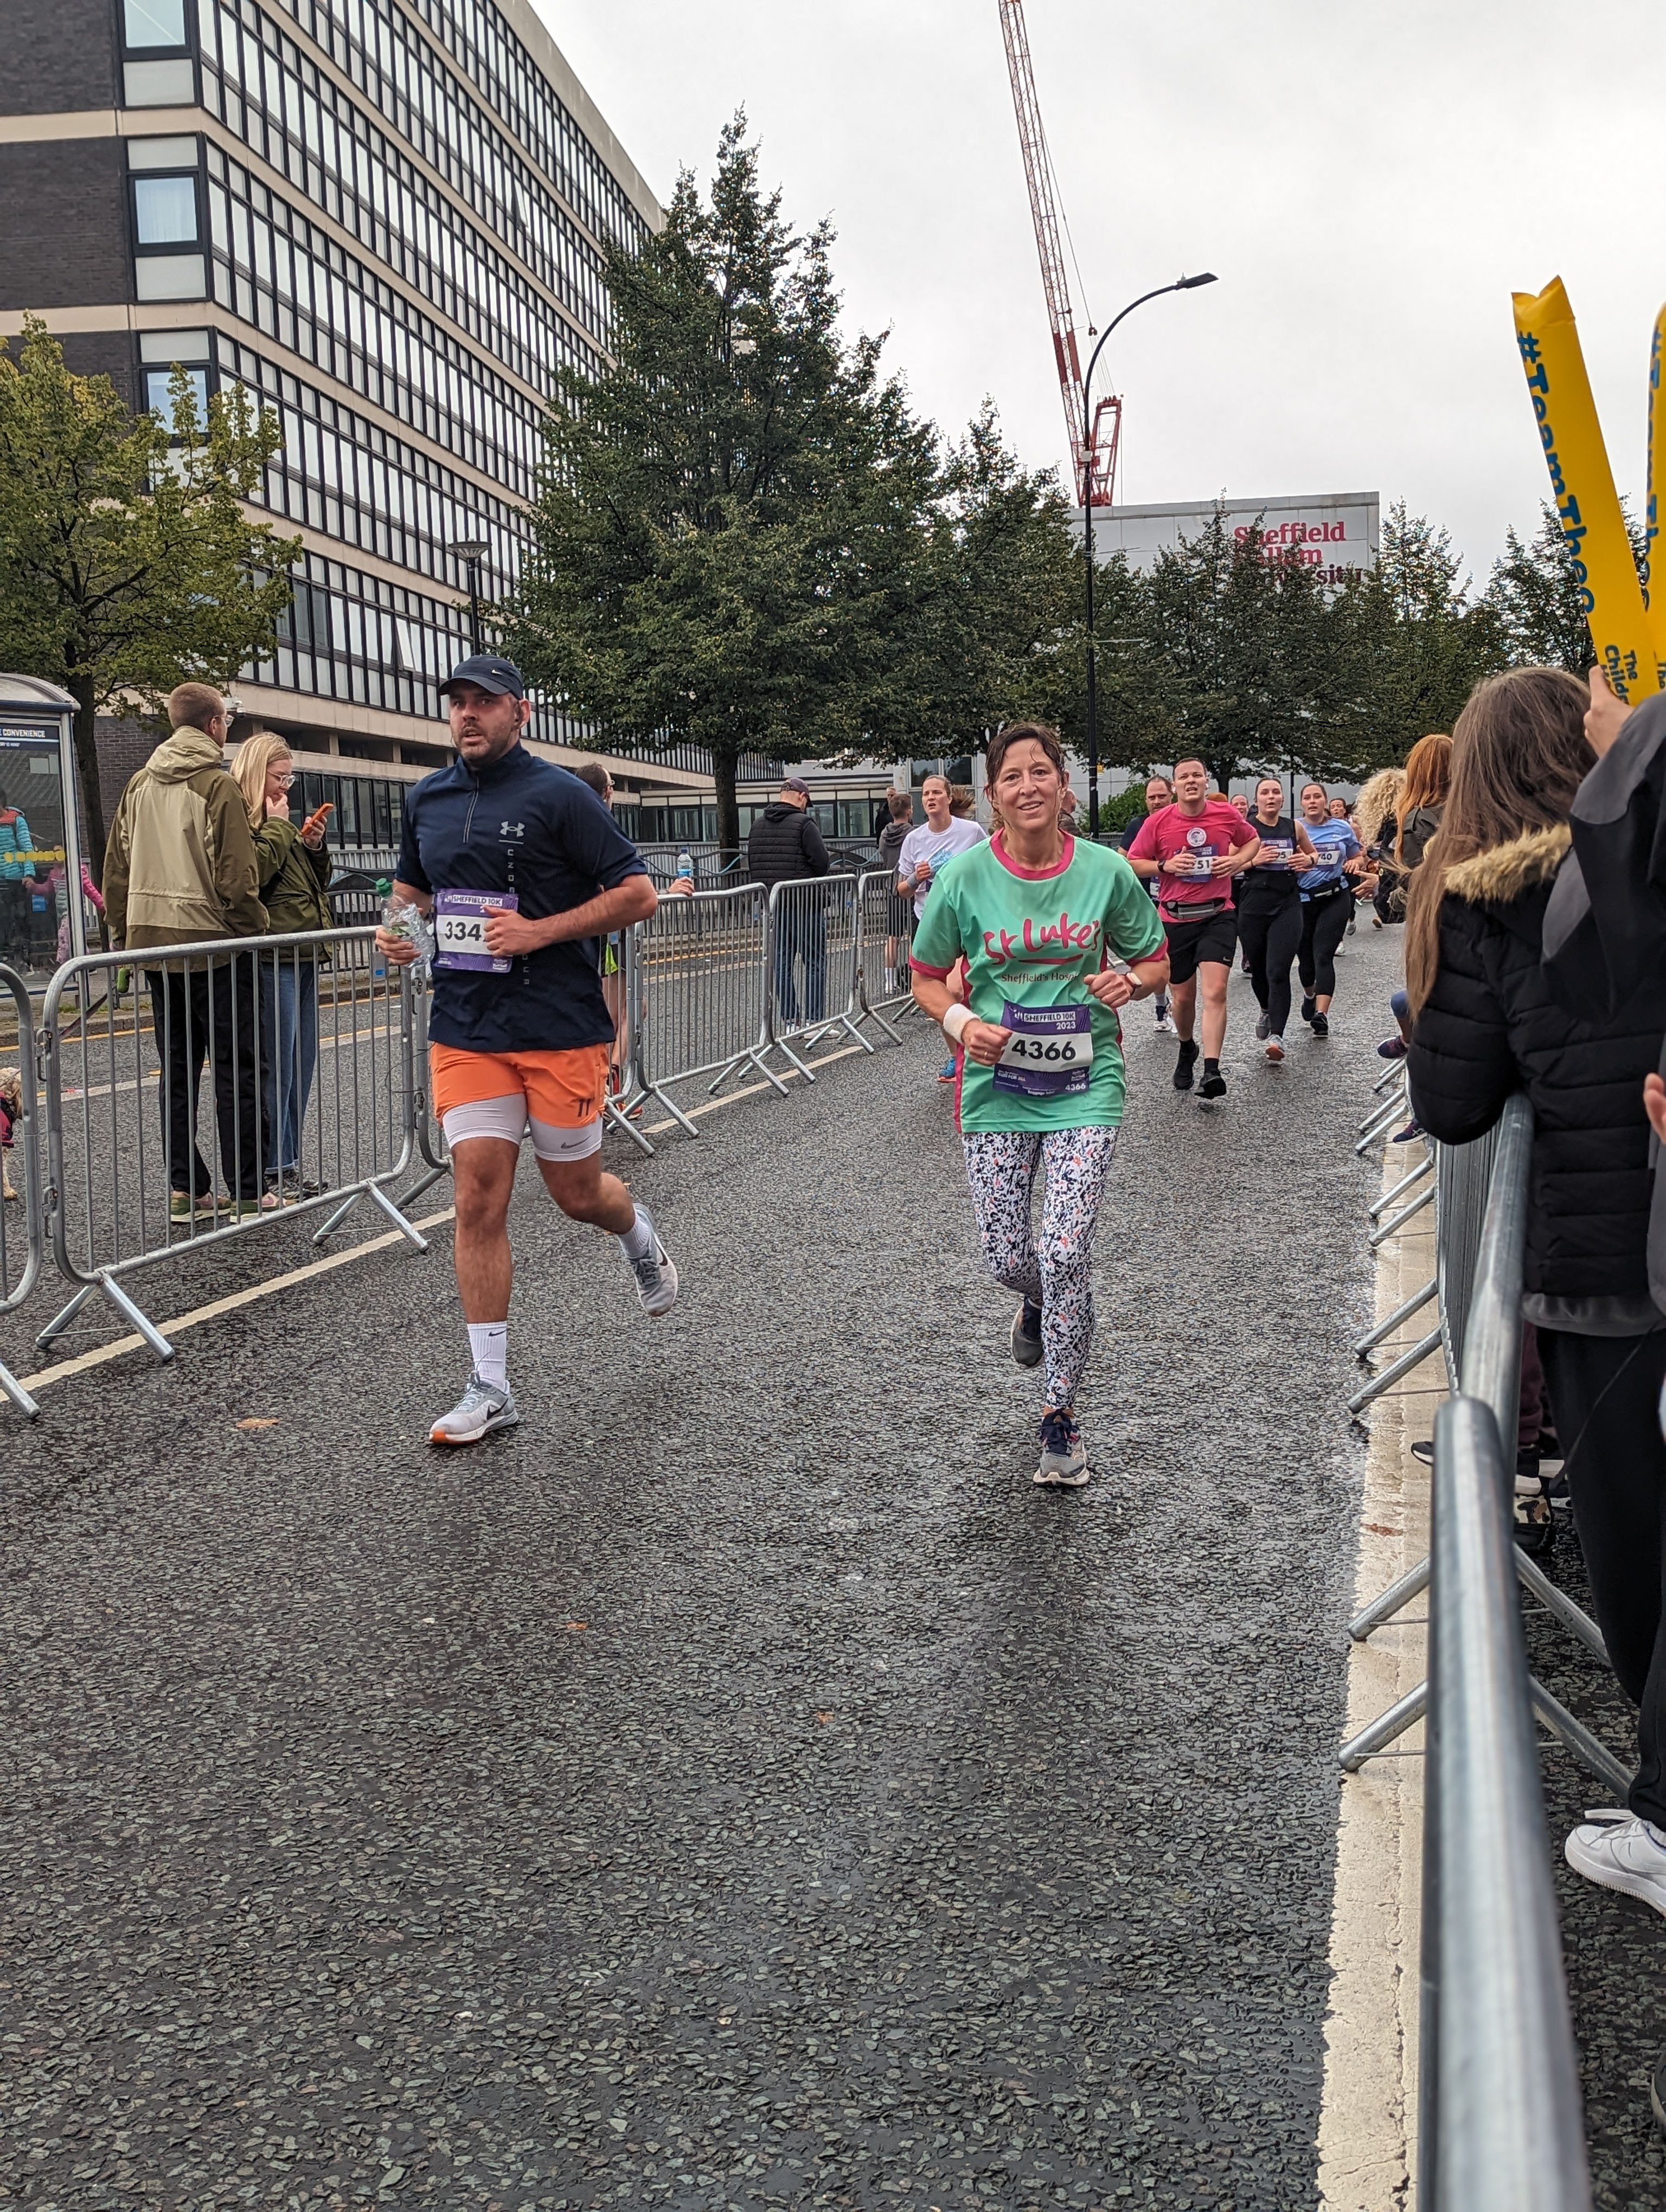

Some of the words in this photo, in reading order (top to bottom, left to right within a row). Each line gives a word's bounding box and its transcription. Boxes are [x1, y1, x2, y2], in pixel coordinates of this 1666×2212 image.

[1623, 650, 1637, 680] The
[1605, 645, 1630, 705] Childr
[3, 729, 46, 737] CONVENIENCE
[1196, 860, 1209, 869] 51
[453, 895, 487, 904] SHEFFIELD
[445, 921, 484, 942] 334
[983, 929, 1018, 964] St
[1023, 912, 1101, 952] Luke's
[1001, 973, 1048, 985] Sheffield's
[1024, 1013, 1061, 1021] SHEFFIELD
[1056, 1021, 1076, 1030] 2023
[1011, 1039, 1076, 1061] 4366
[1065, 1083, 1086, 1091] 4366
